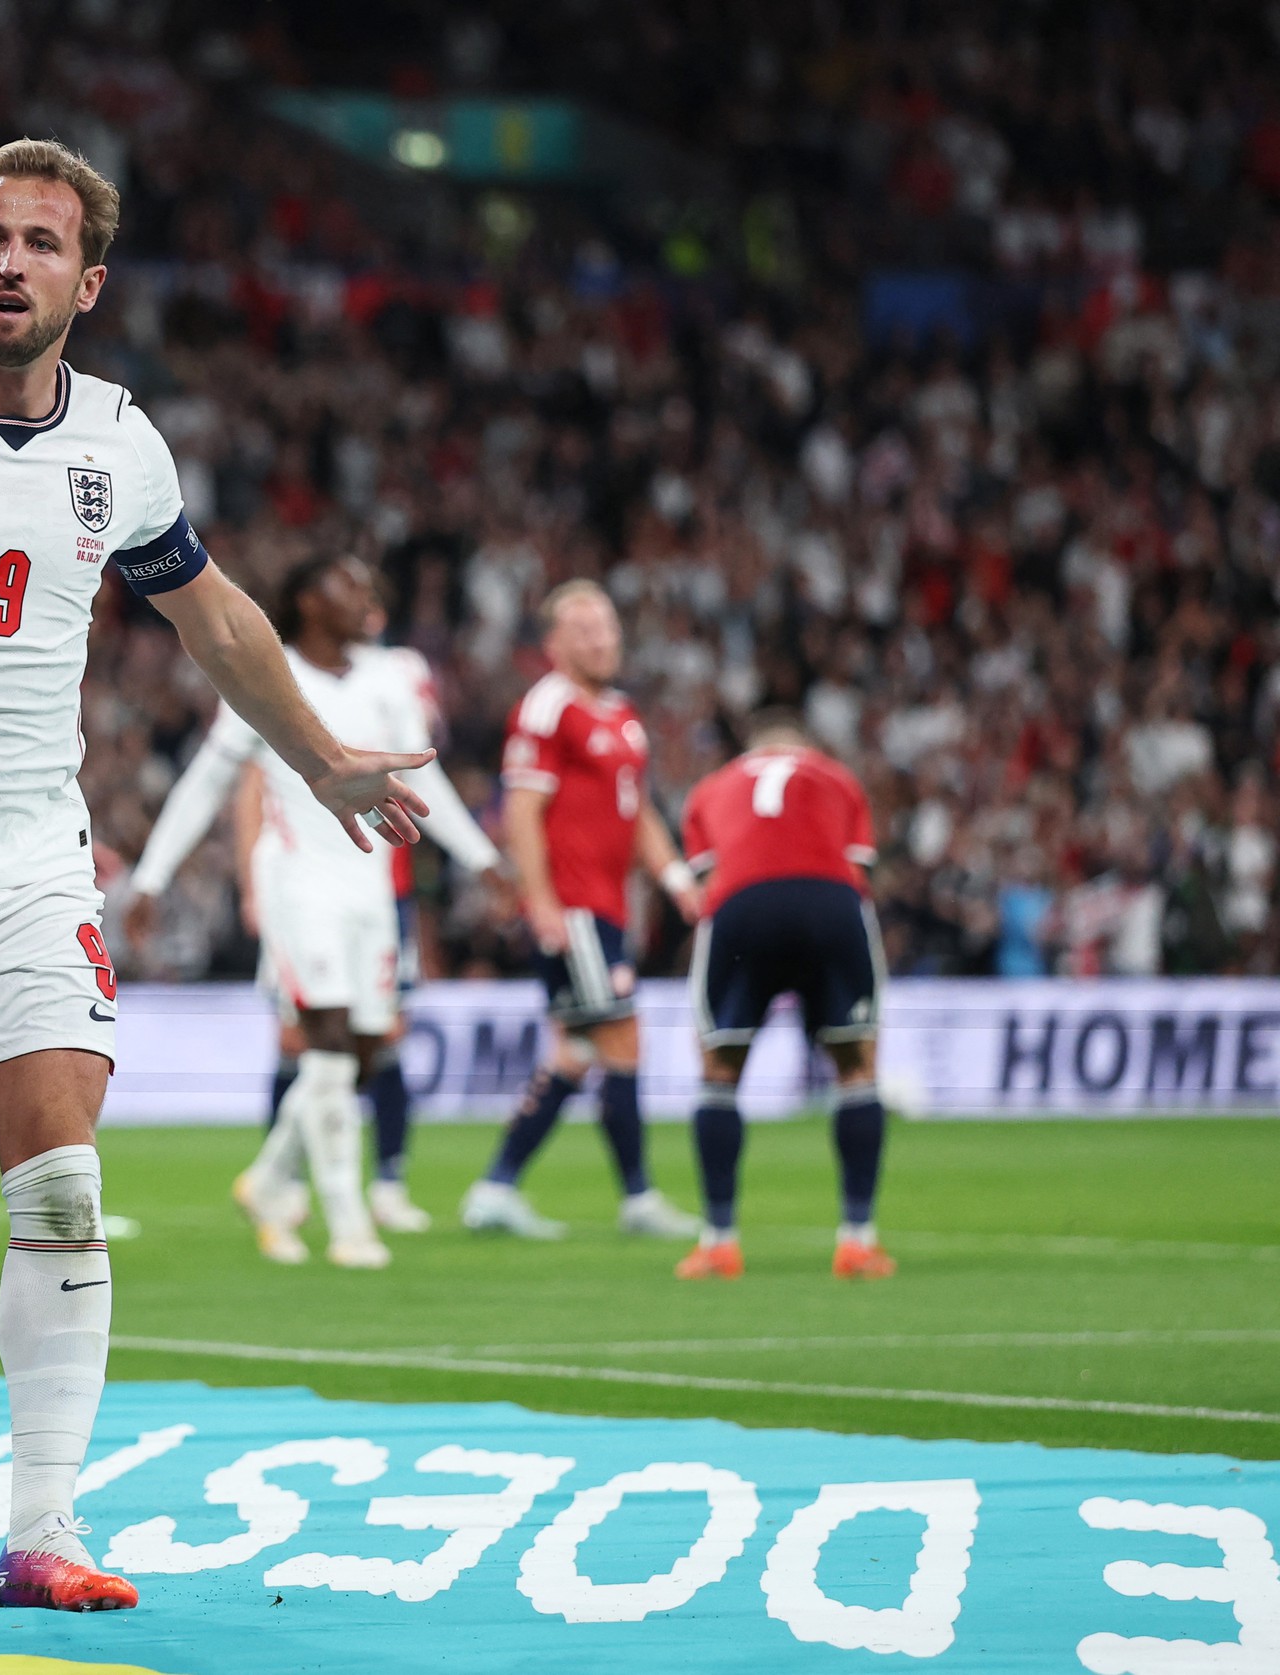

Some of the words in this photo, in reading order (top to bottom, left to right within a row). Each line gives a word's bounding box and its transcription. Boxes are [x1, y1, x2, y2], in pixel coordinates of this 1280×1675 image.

[76, 536, 105, 551] CZECHIA
[131, 550, 183, 578] RESPECT
[742, 754, 799, 819] 7
[76, 922, 117, 1002] 9
[999, 1011, 1280, 1096] HOME
[102, 1436, 982, 1658] DOES
